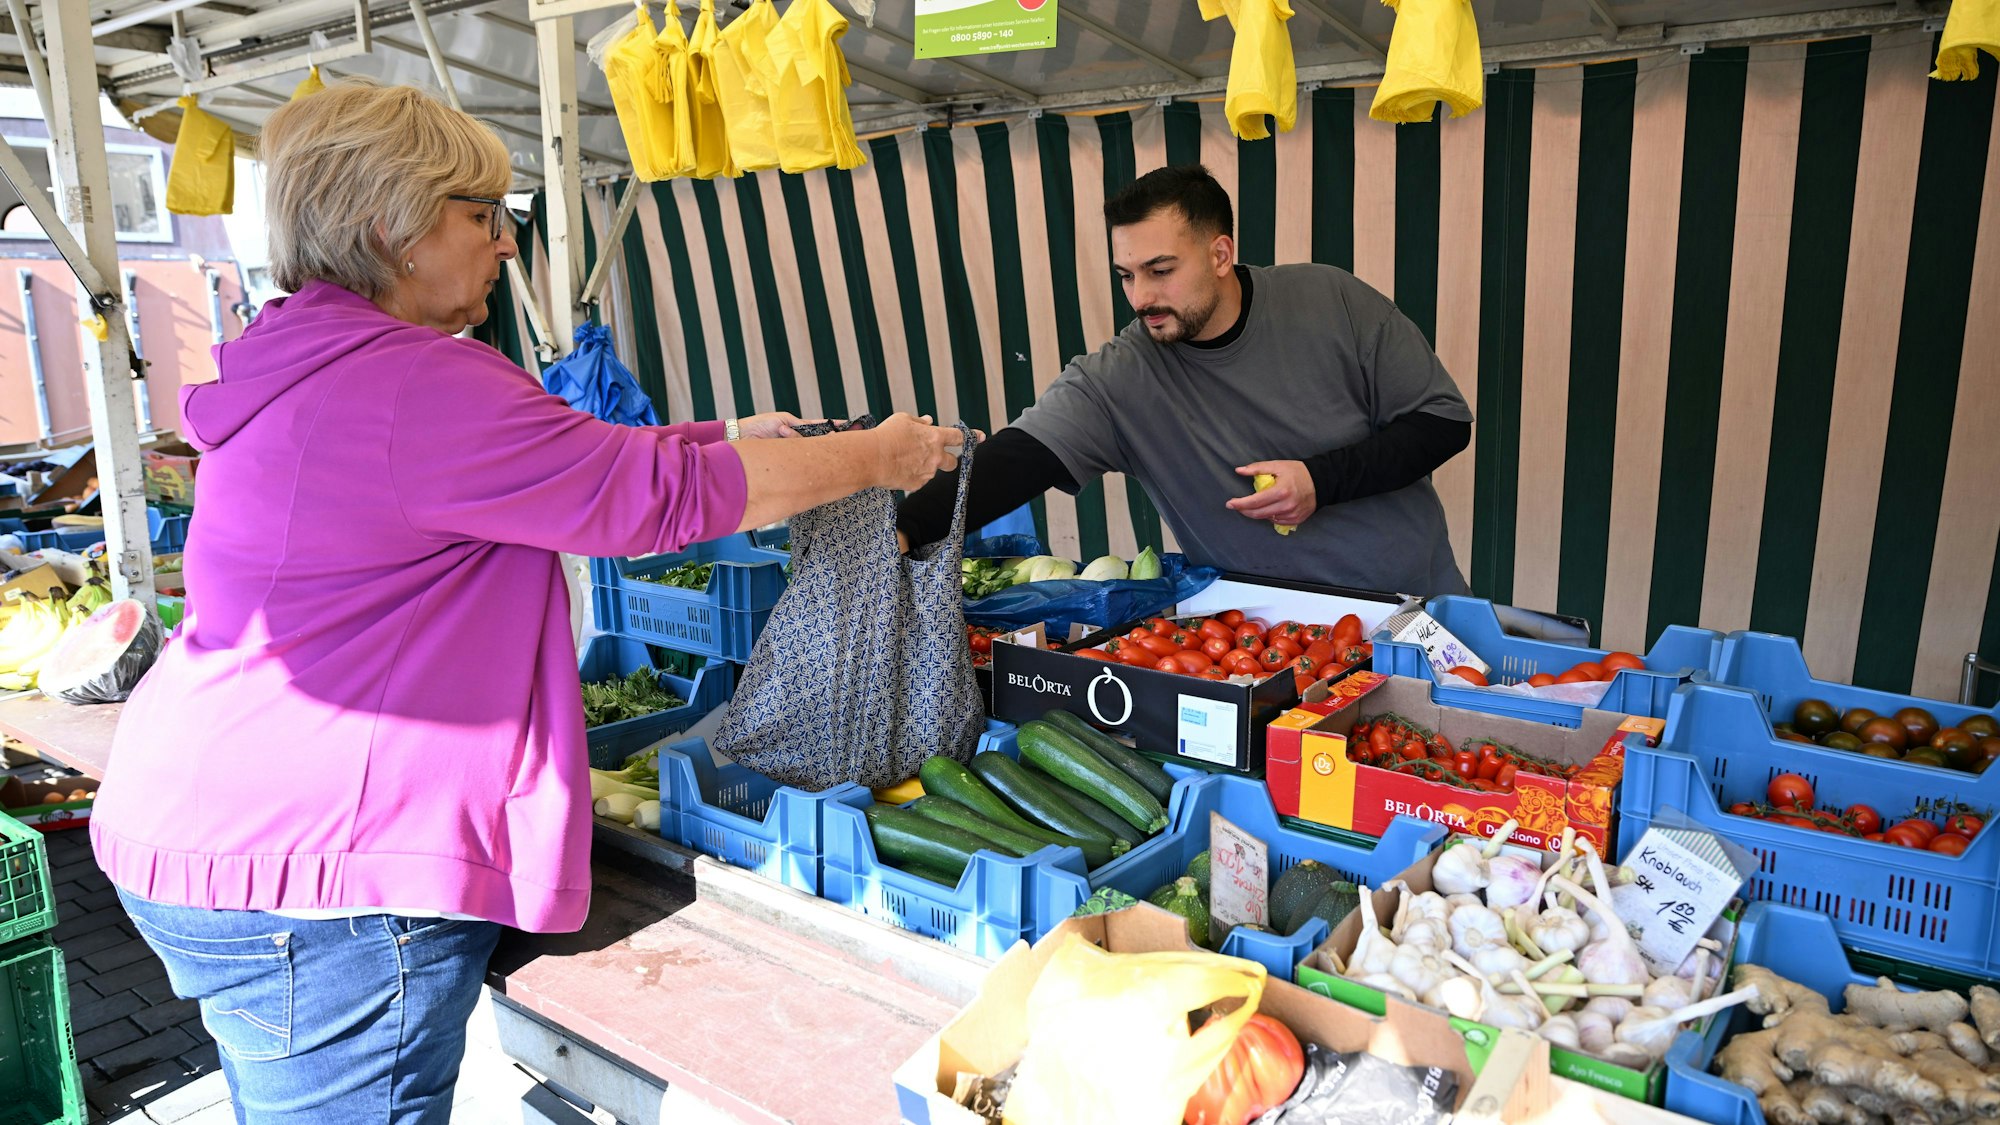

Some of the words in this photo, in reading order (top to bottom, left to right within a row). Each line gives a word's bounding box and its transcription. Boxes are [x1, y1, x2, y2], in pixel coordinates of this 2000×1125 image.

[951, 33, 971, 42] 0800
[972, 31, 992, 41] 5890
[999, 29, 1013, 38] 140
[956, 23, 981, 31] Informationen
[1384, 799, 1467, 829] BELORTA
[1639, 846, 1703, 895] Knoblauch
[1668, 919, 1688, 935] €
[1588, 1068, 1623, 1088] Fresco
